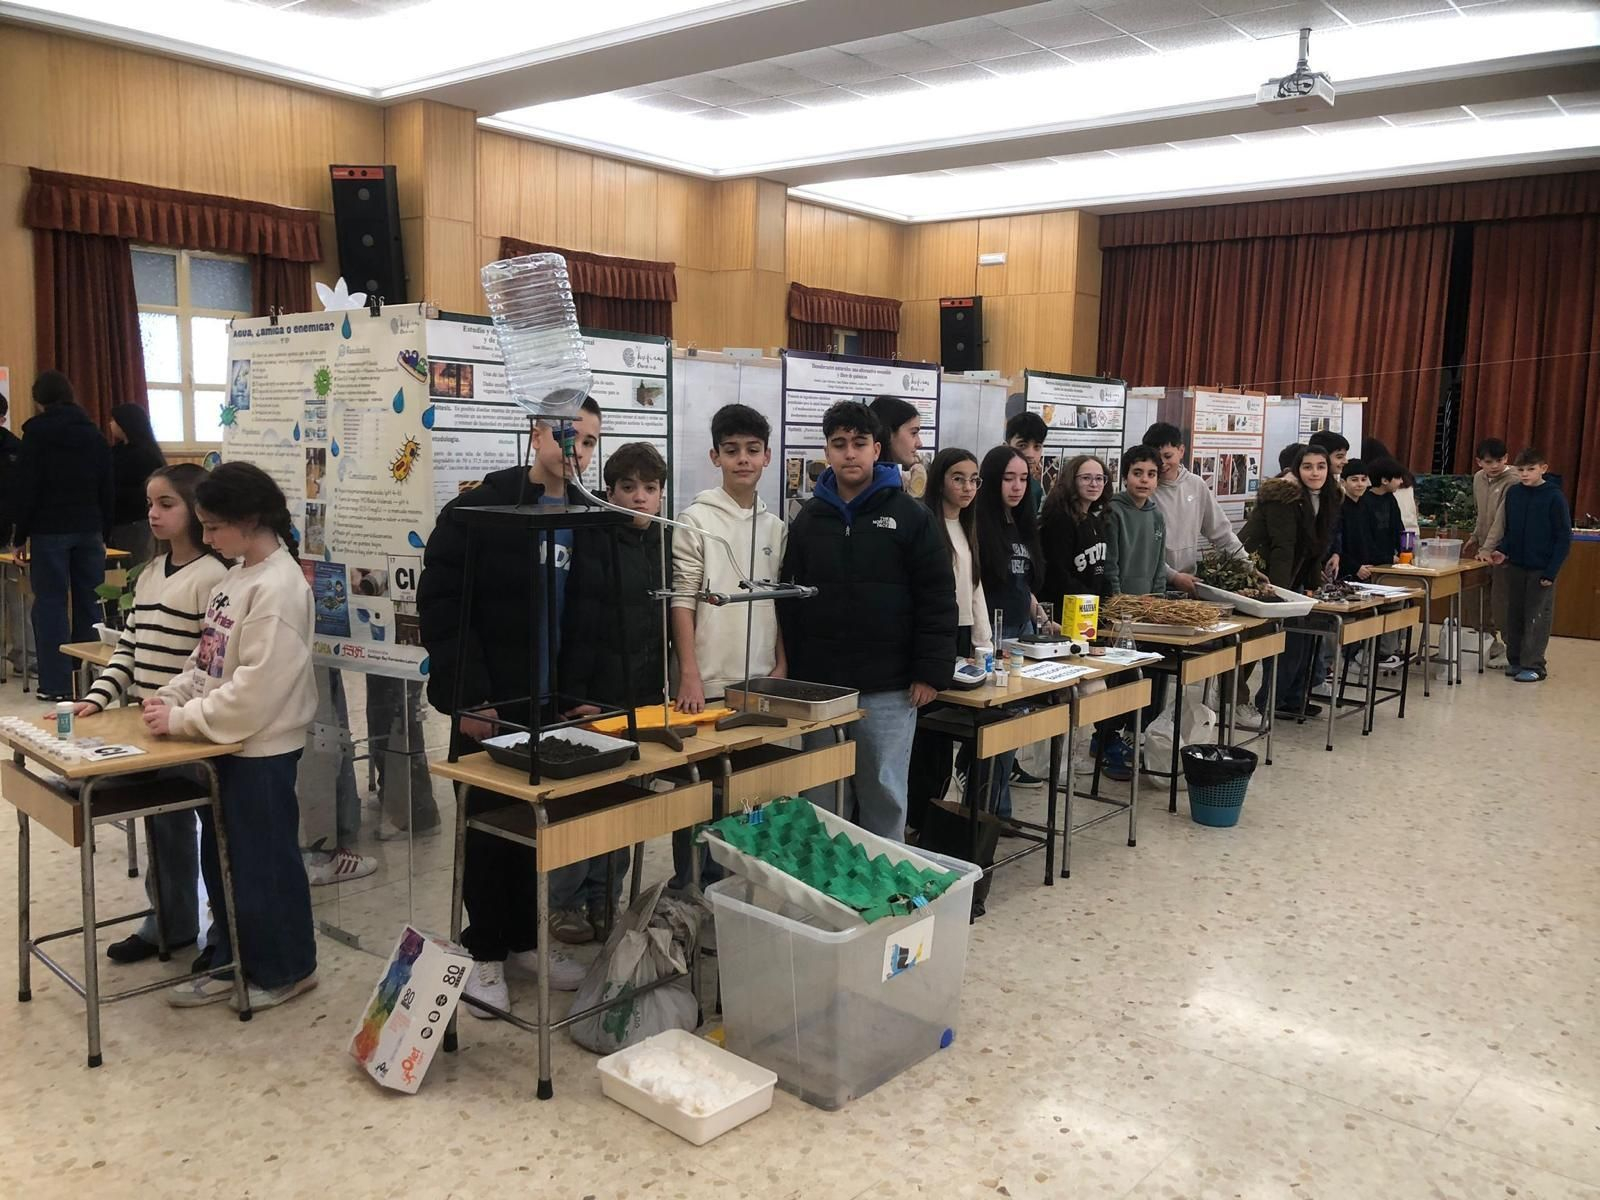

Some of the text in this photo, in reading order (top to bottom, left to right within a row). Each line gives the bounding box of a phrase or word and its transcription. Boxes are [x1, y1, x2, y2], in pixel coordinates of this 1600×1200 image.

[463, 325, 485, 334] Estudio
[395, 567, 416, 590] Cl
[442, 964, 461, 986] 80
